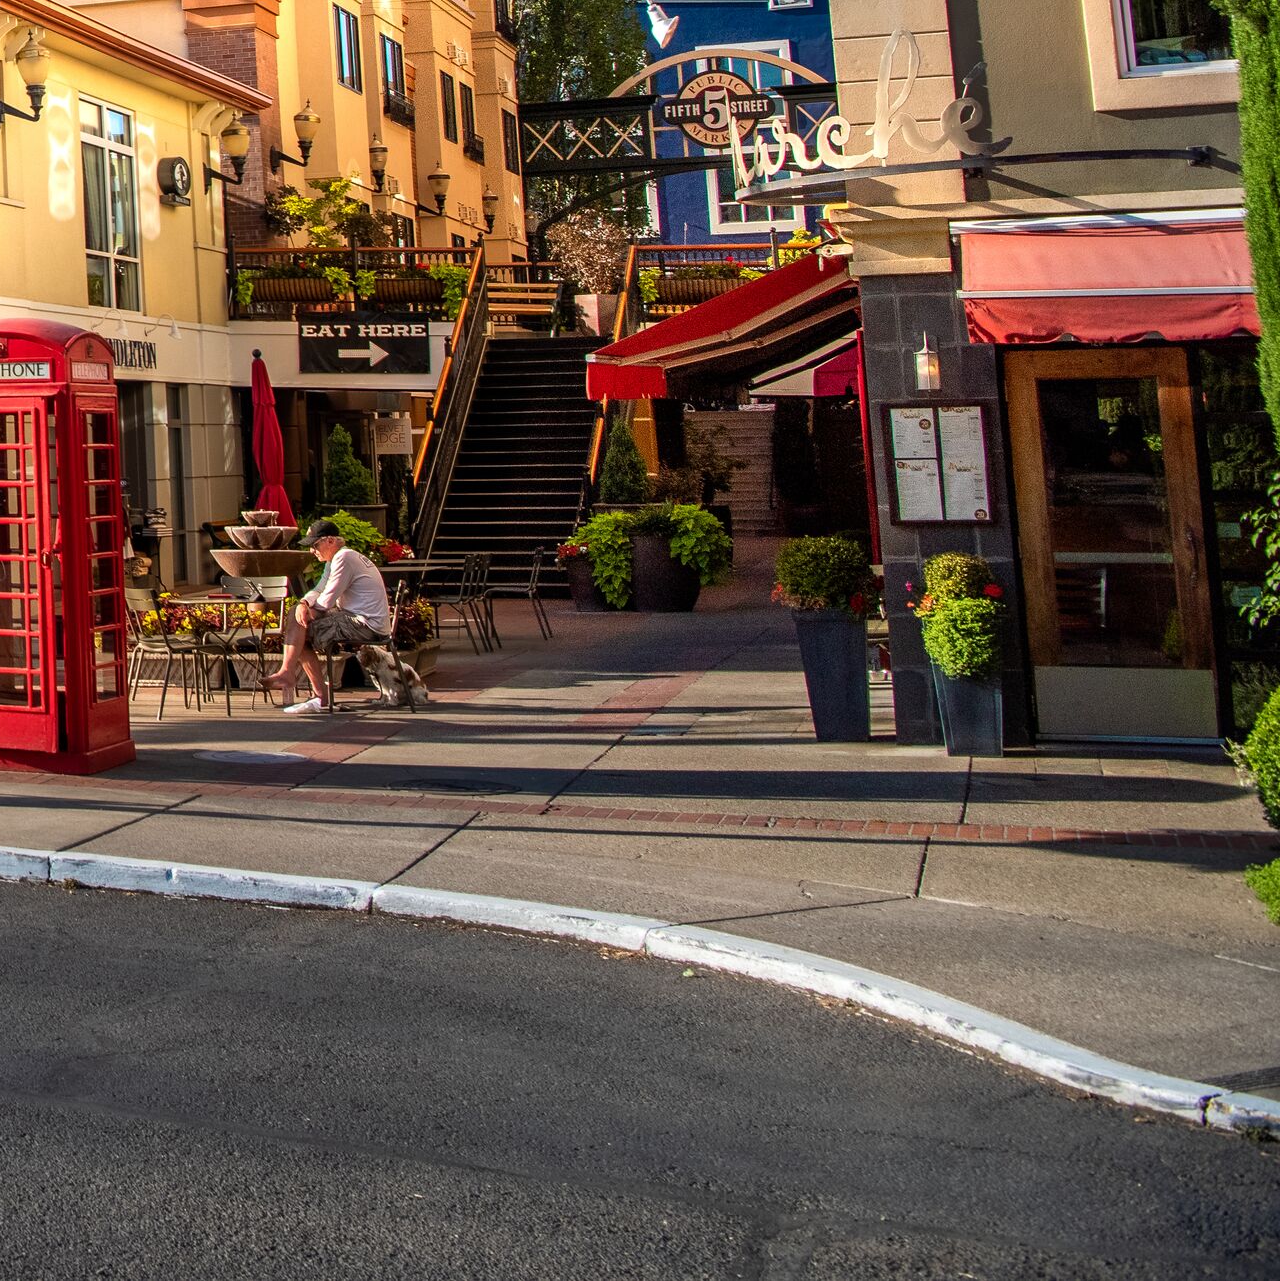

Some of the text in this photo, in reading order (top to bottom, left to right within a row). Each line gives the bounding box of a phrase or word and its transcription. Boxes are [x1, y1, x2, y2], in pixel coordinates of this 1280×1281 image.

[688, 76, 744, 94] PUBLIC
[664, 90, 769, 129] FIFTH 5 STREET
[688, 121, 748, 143] MARKT
[301, 325, 427, 337] EAT HERE
[105, 337, 157, 369] NDLETON
[72, 364, 108, 378] TELEPHONE
